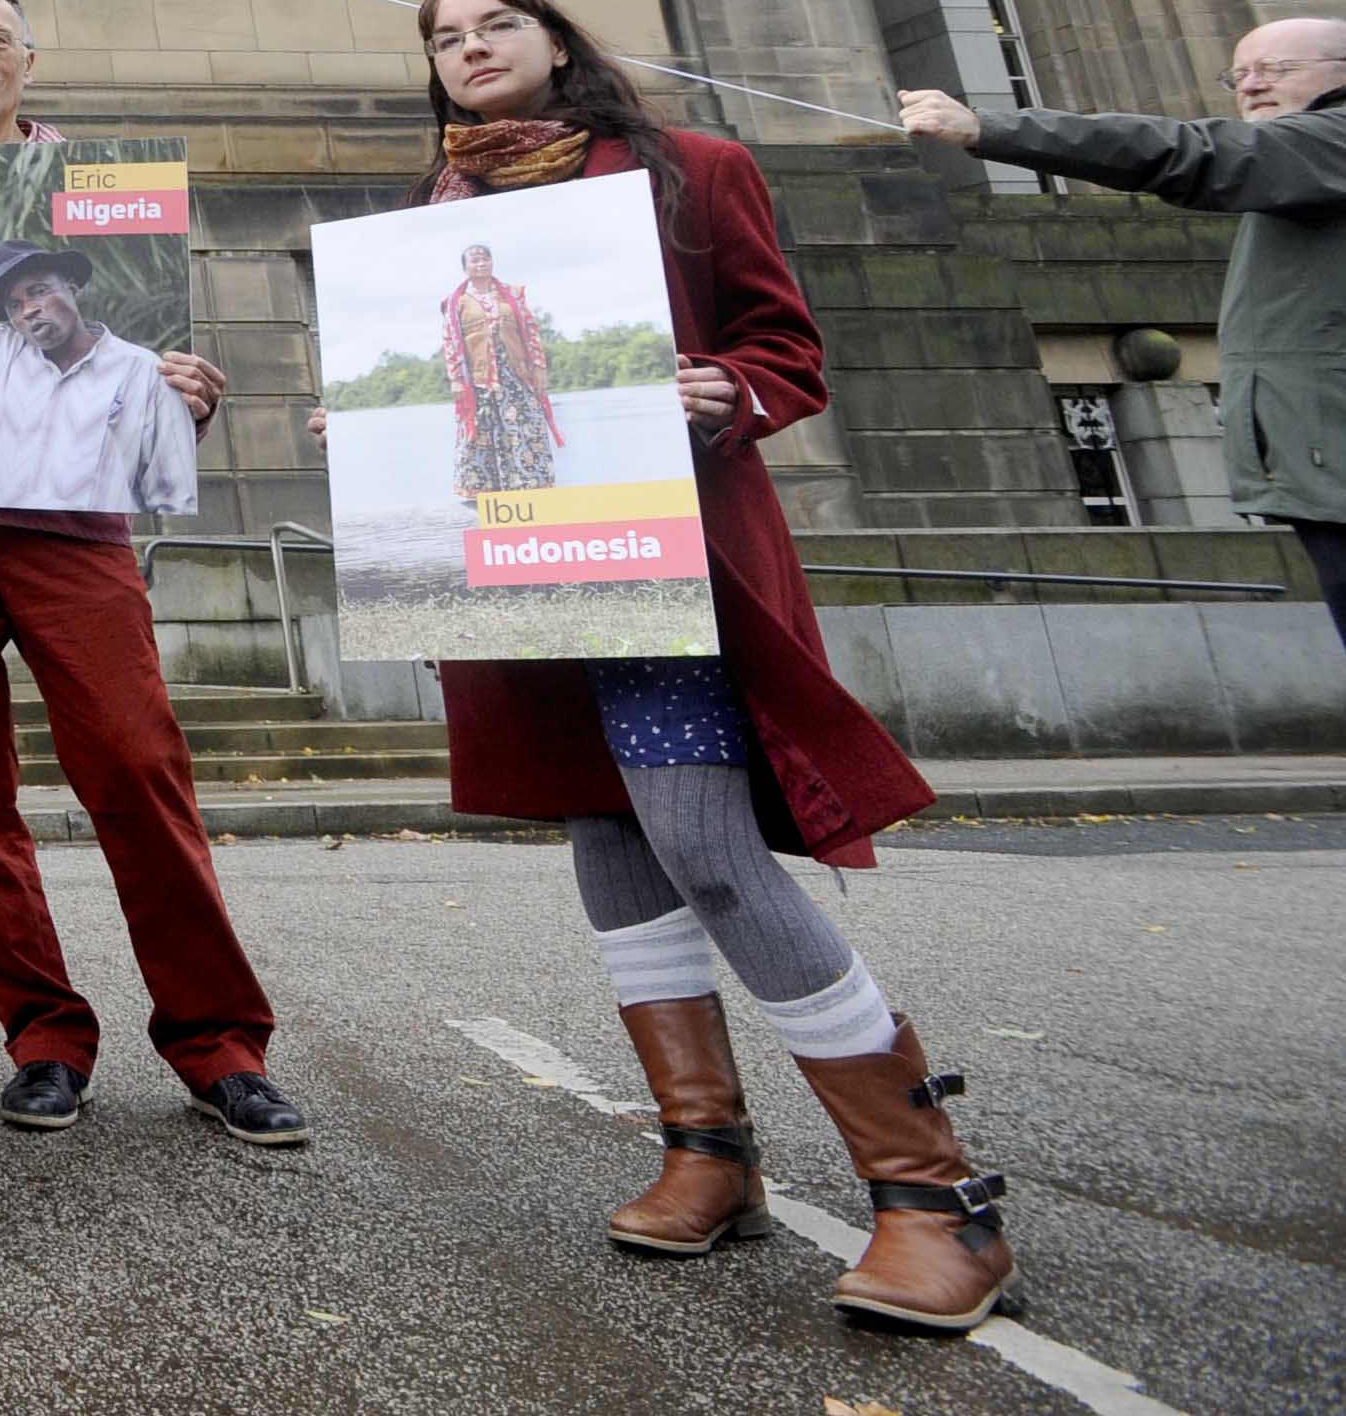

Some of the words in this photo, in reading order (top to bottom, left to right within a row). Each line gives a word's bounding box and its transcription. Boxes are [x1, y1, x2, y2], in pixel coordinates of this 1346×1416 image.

[70, 169, 117, 190] Eric
[66, 198, 161, 225] Nigeria
[485, 498, 534, 524] Ibu
[483, 530, 662, 566] Indonesia
